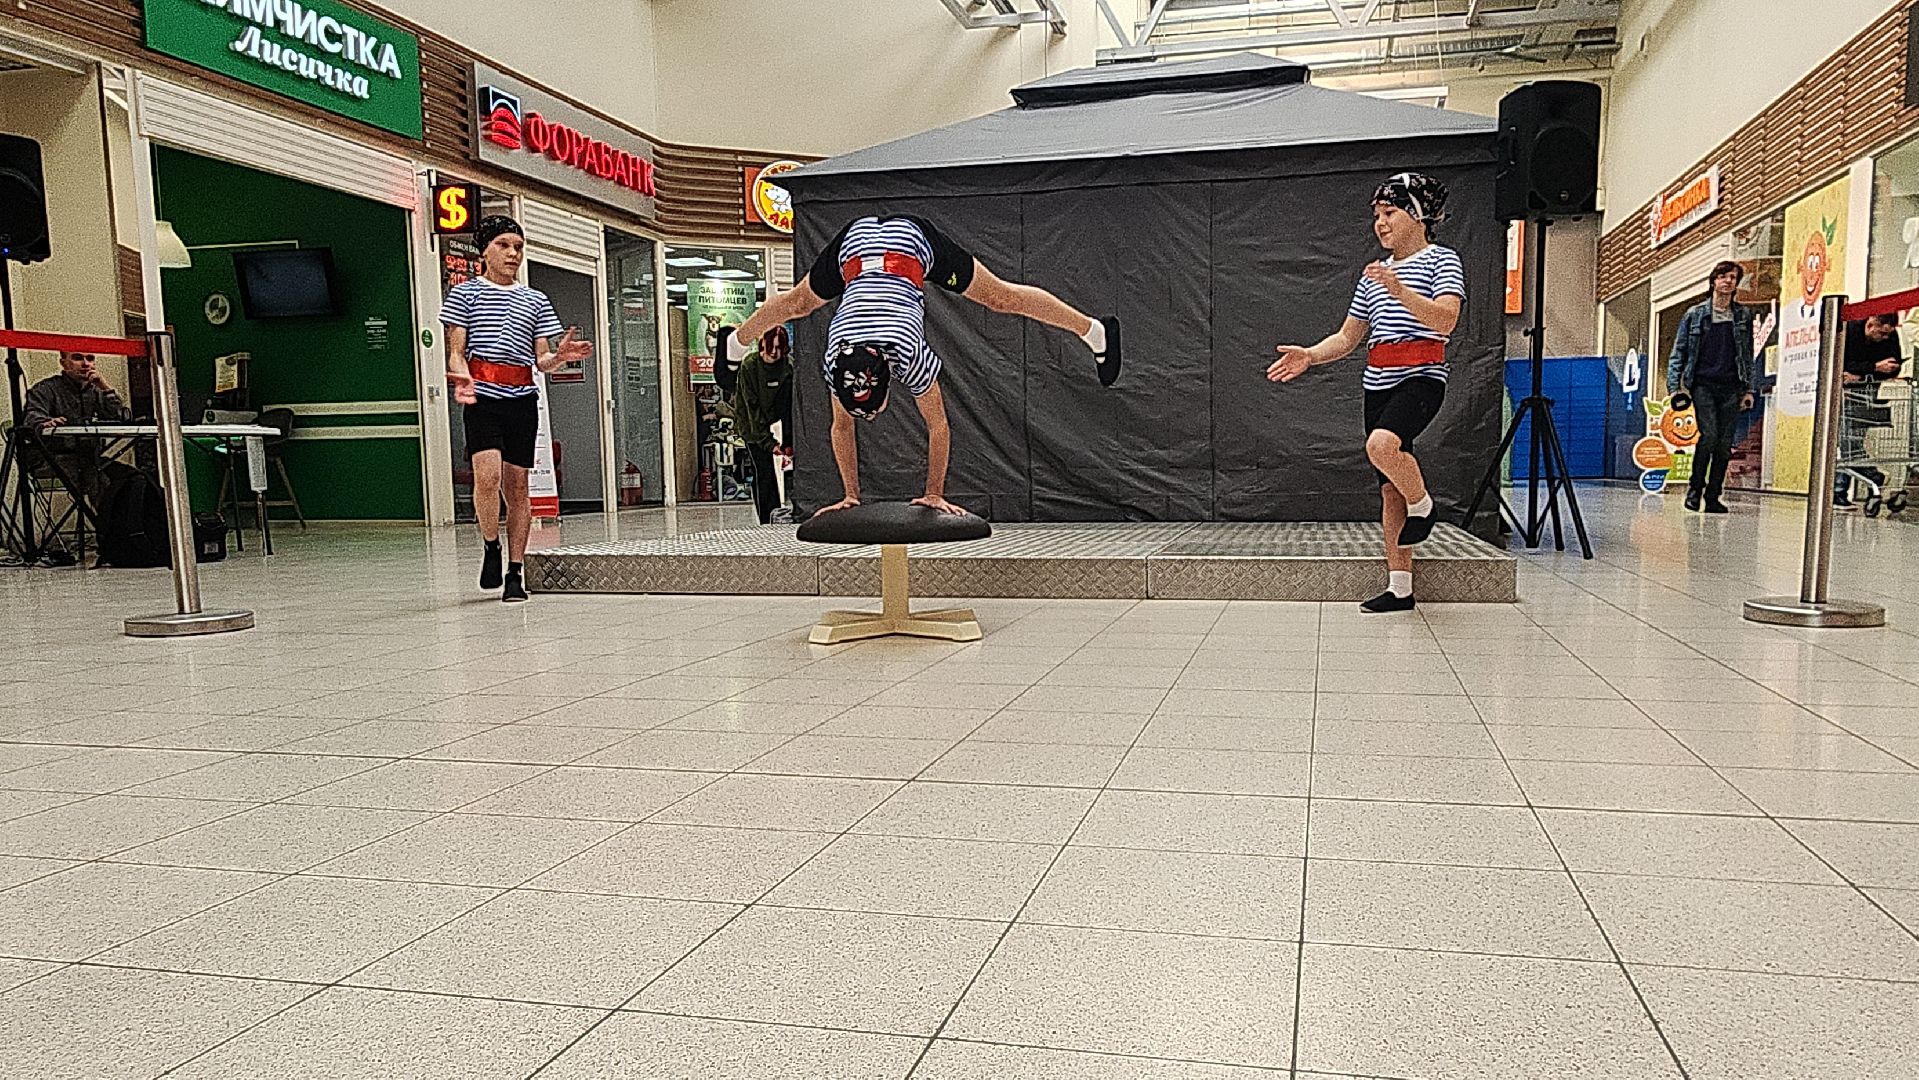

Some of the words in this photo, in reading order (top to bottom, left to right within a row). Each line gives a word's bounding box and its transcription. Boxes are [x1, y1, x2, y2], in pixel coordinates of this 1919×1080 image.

[200, 0, 402, 79] МЧИСТКА
[230, 26, 370, 99] Лисичка
[524, 113, 656, 196] ФОРАБАНК
[439, 187, 467, 229] $
[699, 296, 747, 305] ПИТОМЦЕВ
